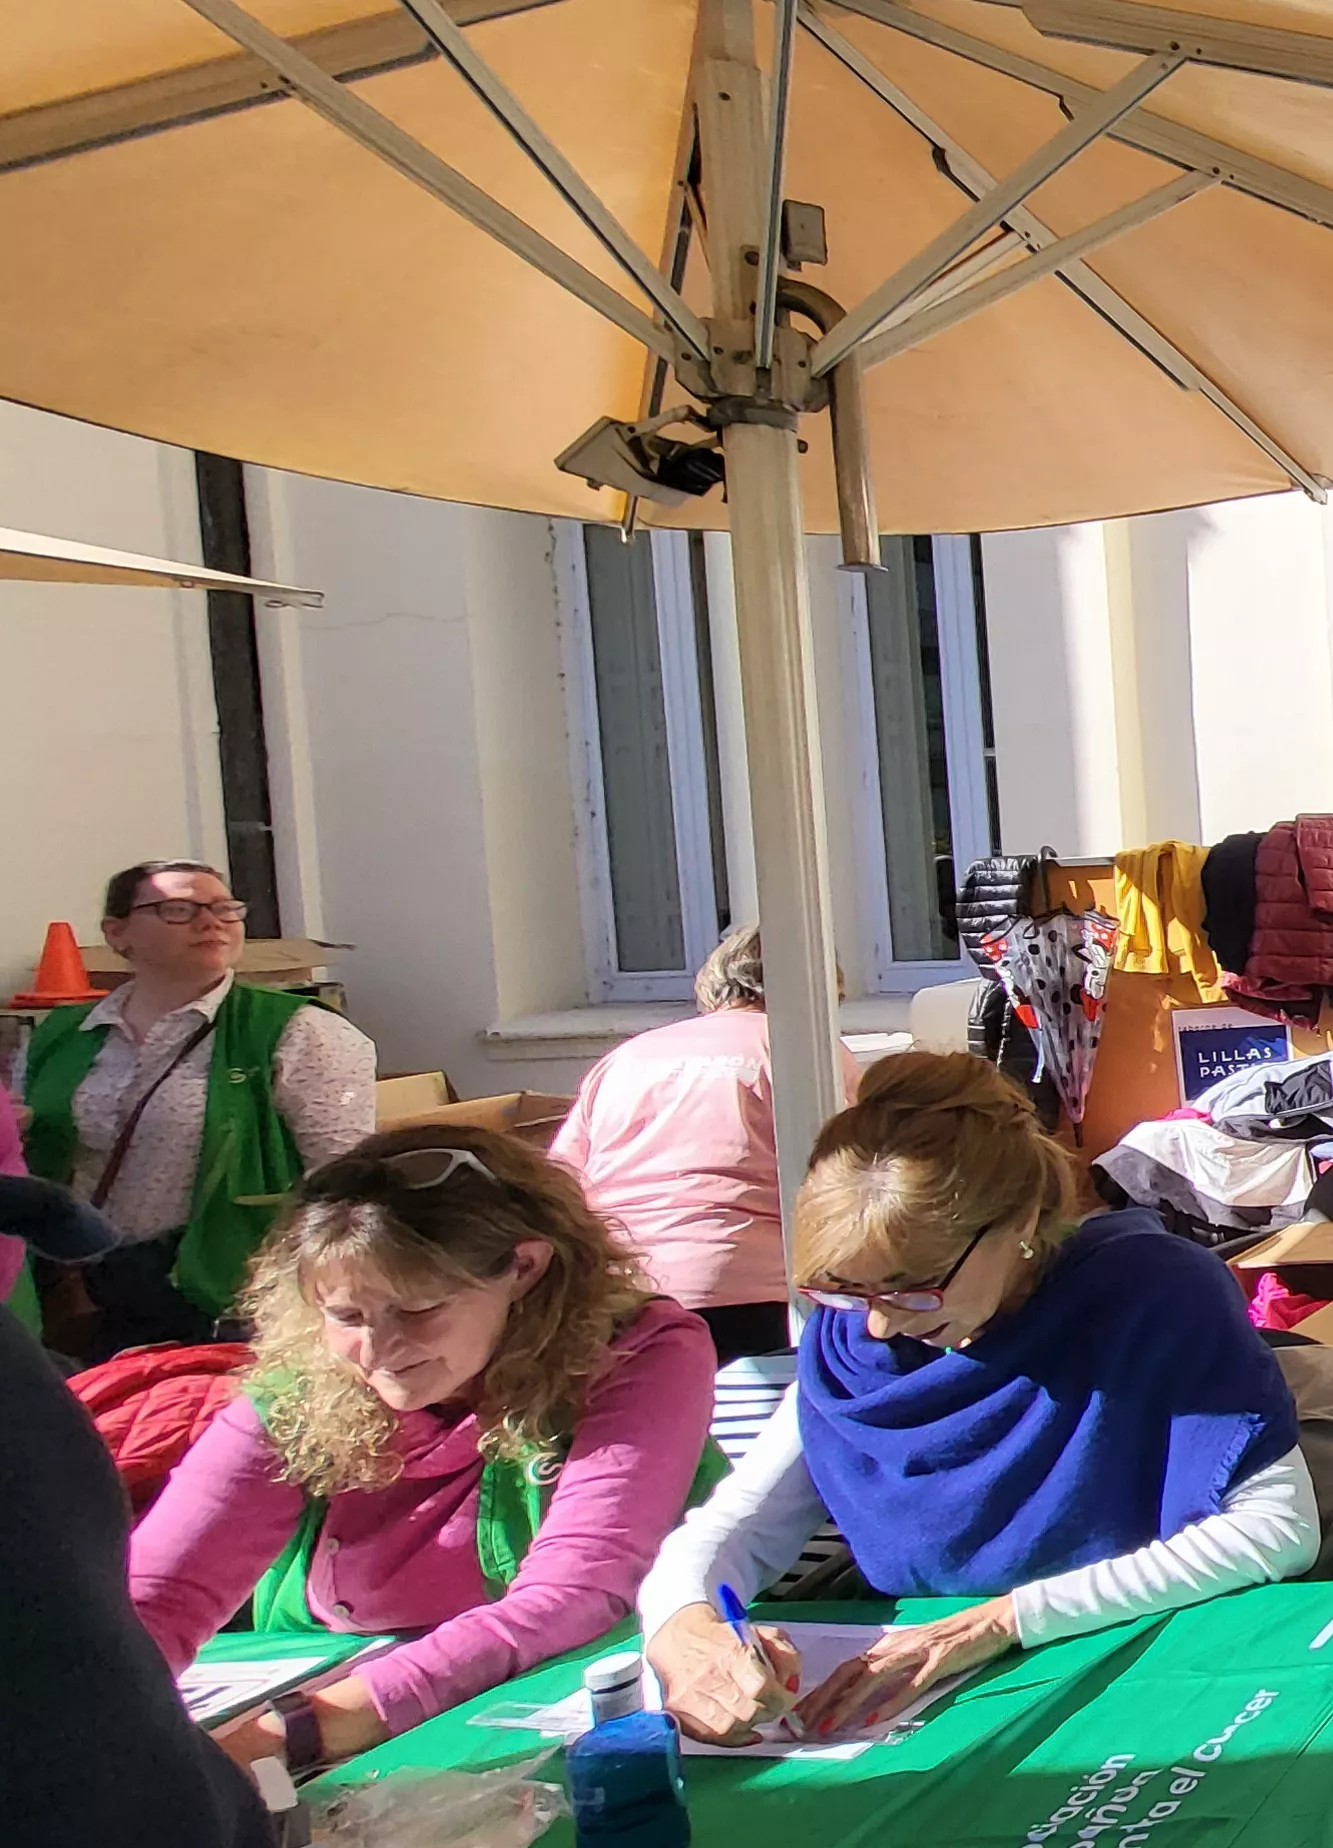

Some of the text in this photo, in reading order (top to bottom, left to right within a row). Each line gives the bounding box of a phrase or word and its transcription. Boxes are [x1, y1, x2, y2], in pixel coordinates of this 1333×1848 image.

[1198, 1046, 1272, 1064] LILLAS
[1199, 1062, 1254, 1078] PAST
[1168, 1766, 1207, 1796] el
